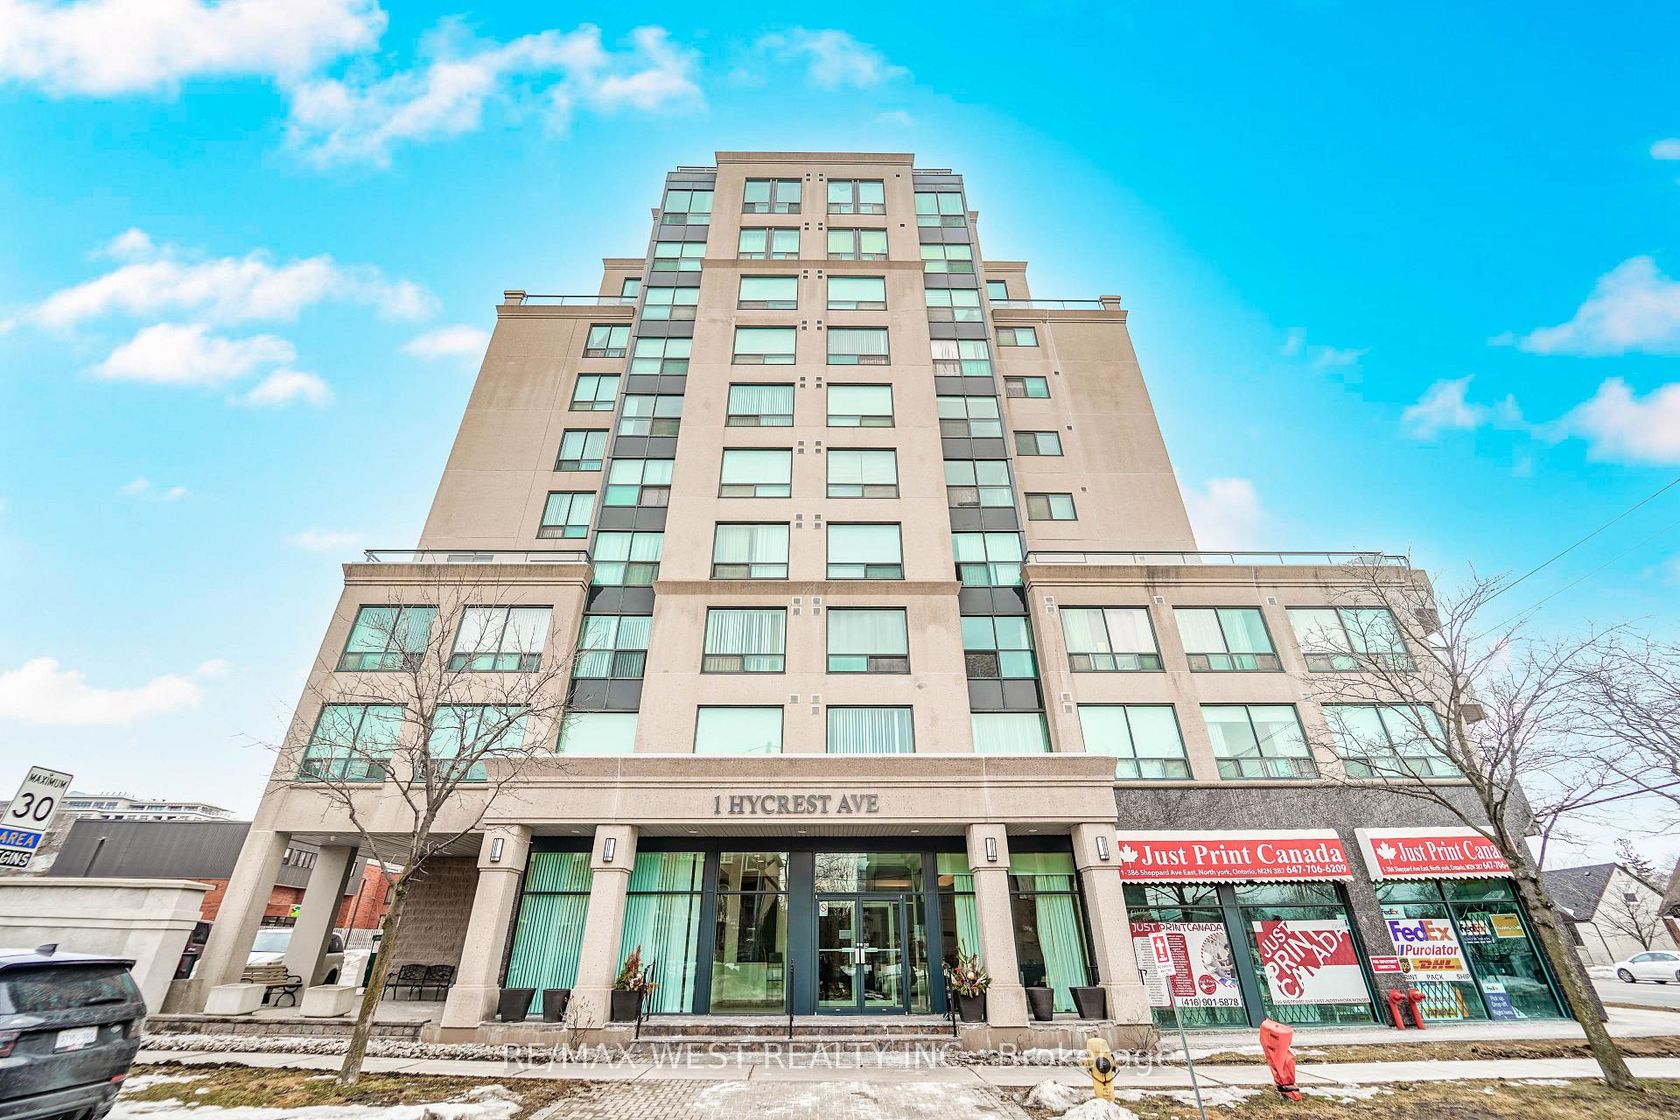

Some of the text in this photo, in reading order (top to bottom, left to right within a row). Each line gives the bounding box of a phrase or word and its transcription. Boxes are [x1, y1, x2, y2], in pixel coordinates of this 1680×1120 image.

[27, 772, 68, 789] MAXIMUM
[12, 792, 54, 822] 30
[713, 794, 880, 815] 1 HYCREST AVE
[0, 830, 34, 847] AREA
[1141, 843, 1344, 866] Just Print Canada
[1397, 840, 1504, 862] Just Print Cana
[1140, 868, 1170, 877] Sheppard
[1198, 868, 1215, 876] North
[1286, 864, 1347, 874] 647-706-6209
[1132, 923, 1156, 932] JUST
[1388, 920, 1454, 942] FedEx
[1261, 920, 1292, 958] JUST
[1405, 944, 1458, 956] Purolator
[1280, 928, 1350, 999] CANADA
[1418, 960, 1455, 970] DHL
[1182, 998, 1240, 1006] (416) 901-5878
